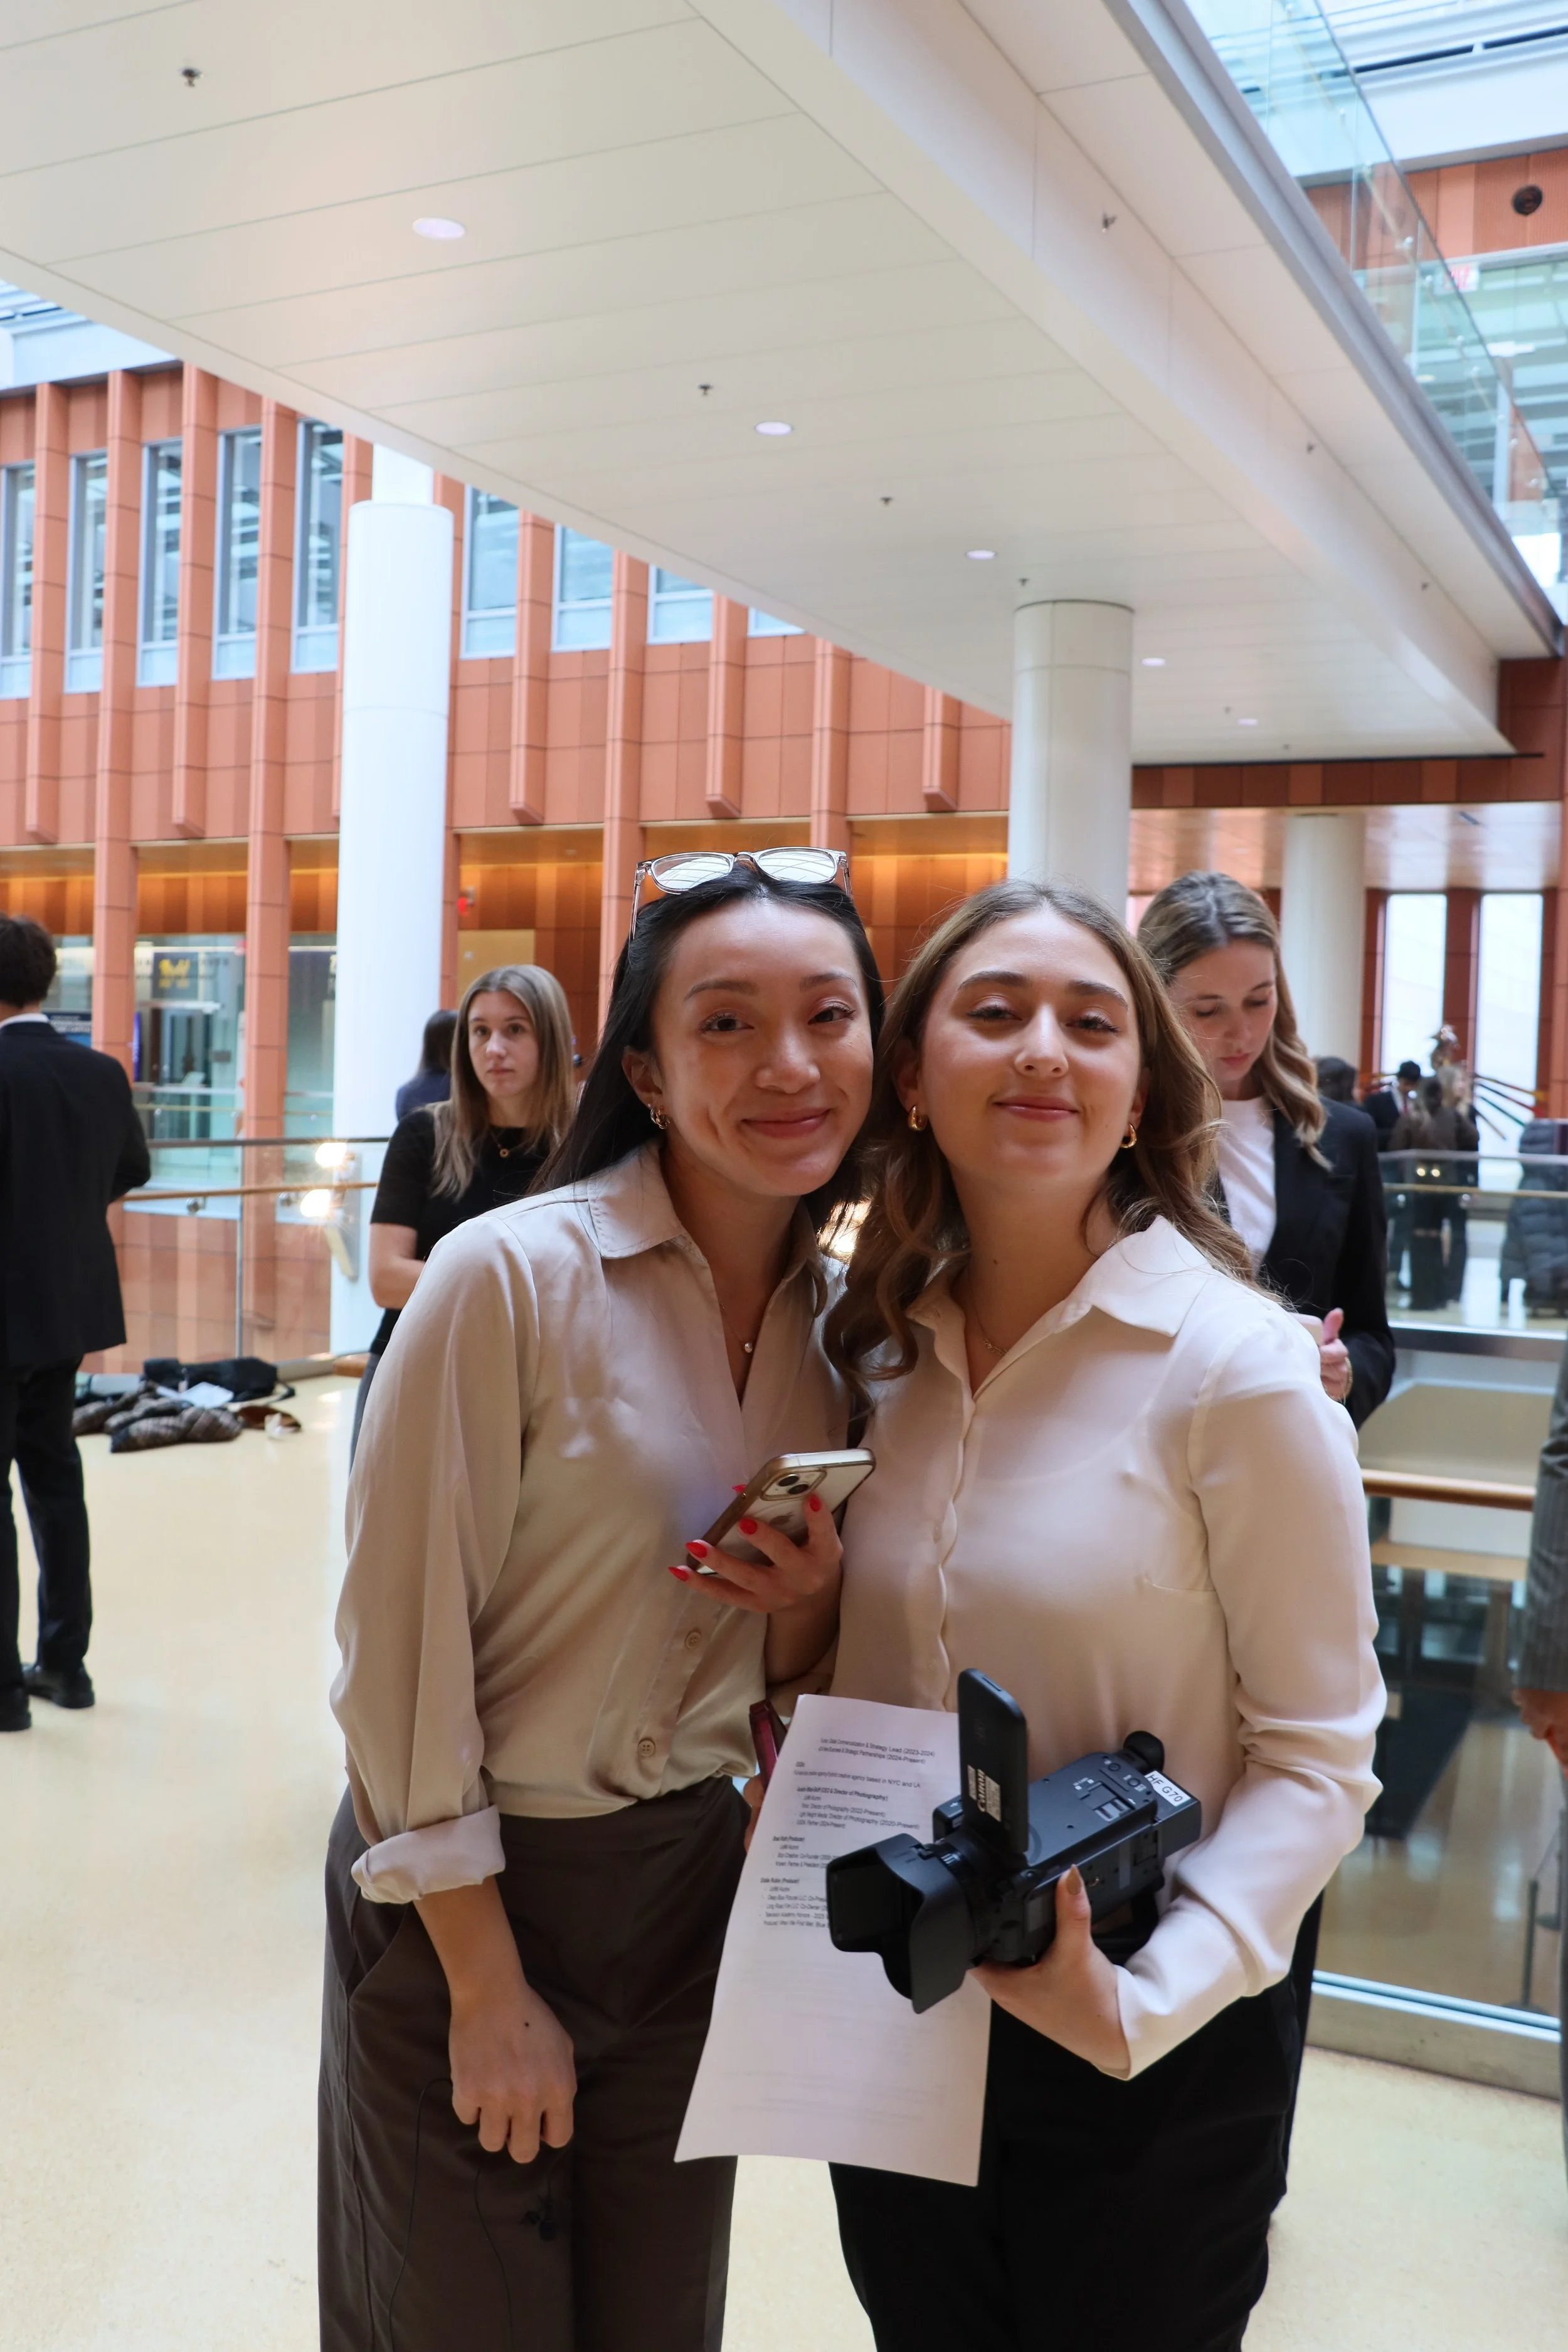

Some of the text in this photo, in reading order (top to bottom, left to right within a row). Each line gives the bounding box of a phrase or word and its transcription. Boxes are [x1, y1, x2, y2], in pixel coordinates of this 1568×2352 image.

[869, 1743, 887, 1752] Strategy
[886, 1754, 926, 1764] (2024-Present)
[1147, 1774, 1184, 1803] HF G70
[849, 1815, 878, 1825] Photography
